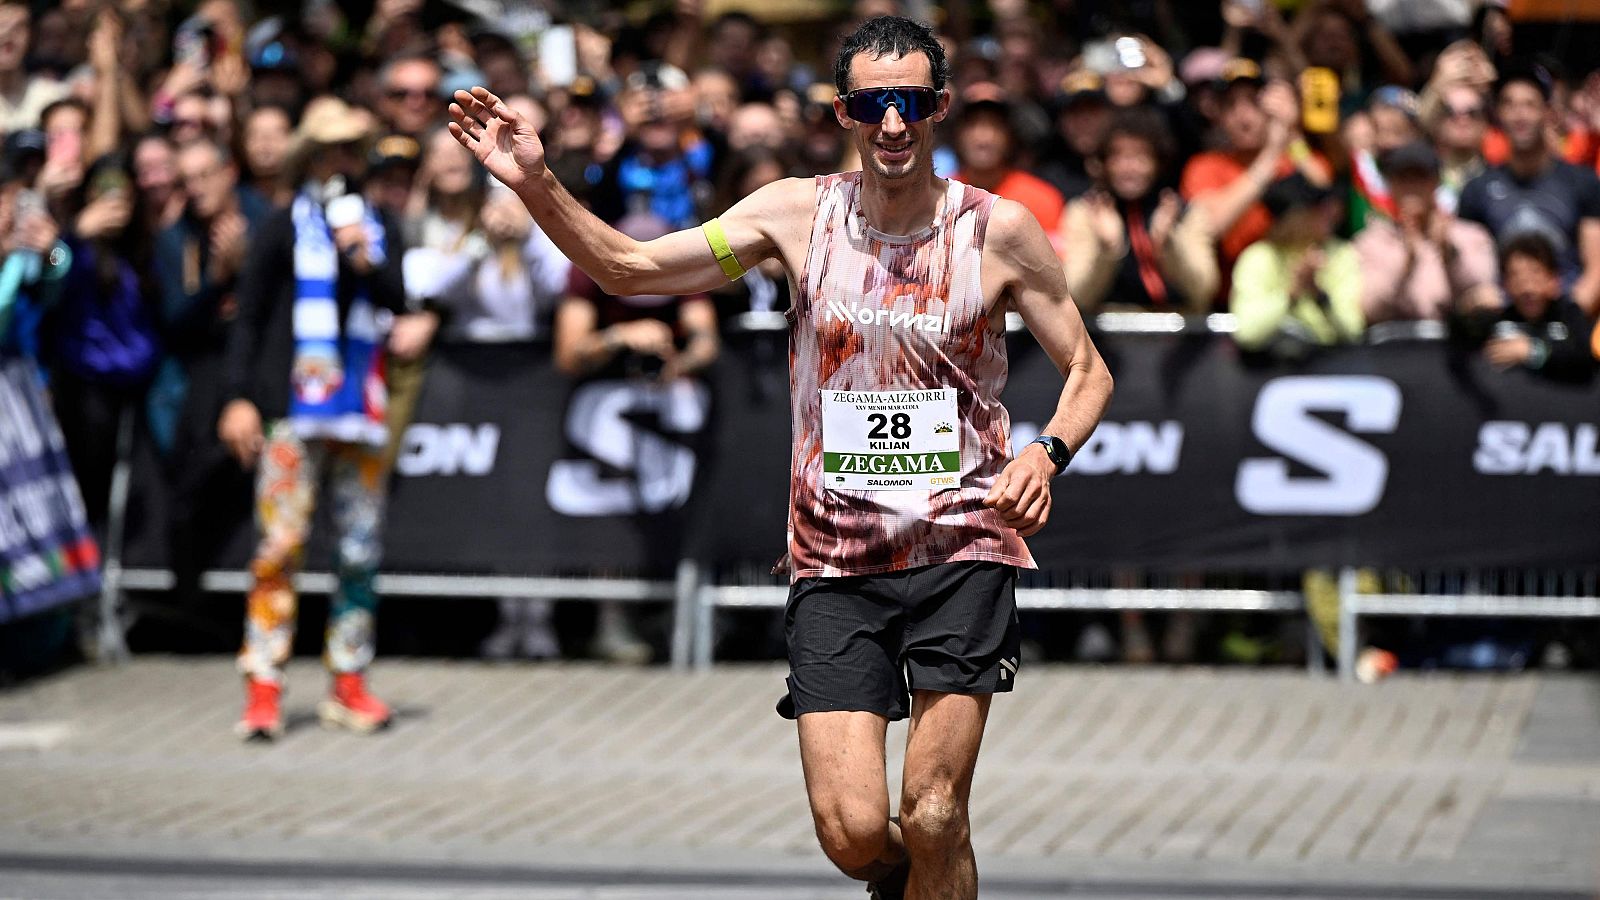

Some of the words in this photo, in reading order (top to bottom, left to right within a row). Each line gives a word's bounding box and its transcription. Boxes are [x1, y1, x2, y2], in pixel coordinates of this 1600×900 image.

[833, 391, 946, 404] ZEGAMA-AIZKORRI
[867, 412, 912, 440] 28
[869, 441, 910, 450] KILIAN
[1235, 374, 1401, 516] S
[839, 454, 945, 474] ZEGAMA
